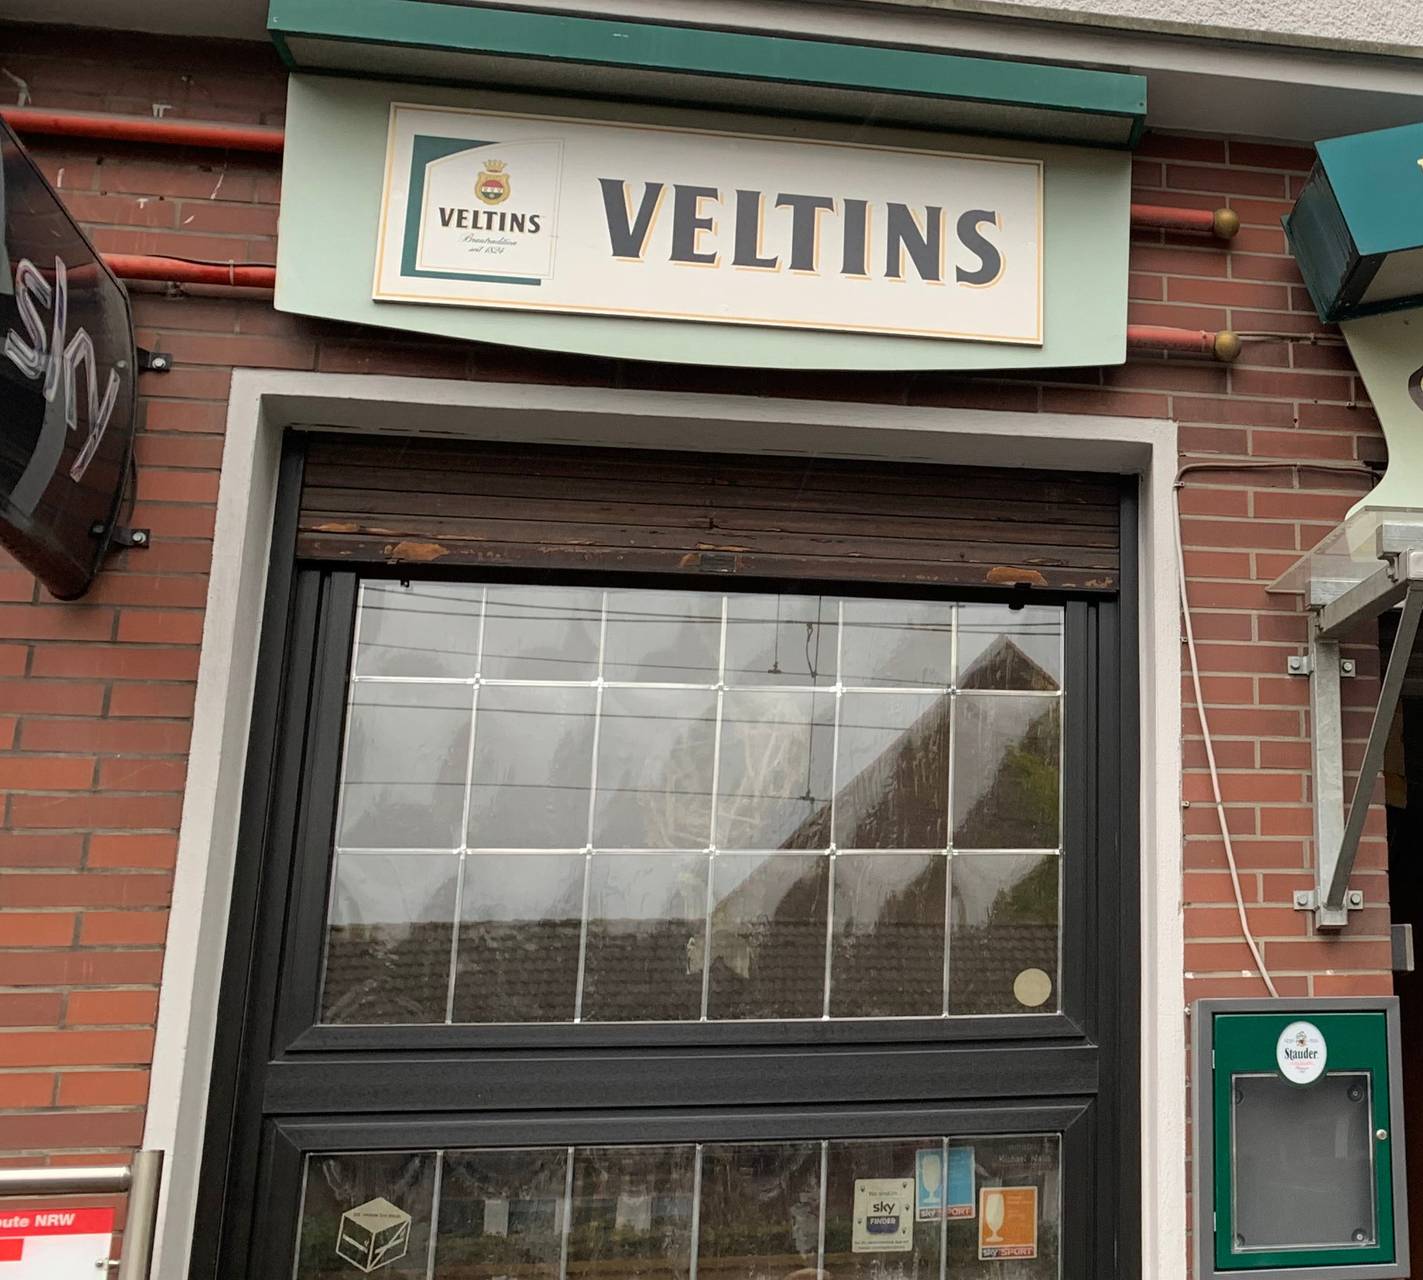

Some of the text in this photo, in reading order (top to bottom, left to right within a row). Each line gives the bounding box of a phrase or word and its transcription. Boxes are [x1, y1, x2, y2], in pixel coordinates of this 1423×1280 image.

[438, 207, 541, 234] VELTINS
[597, 177, 1006, 288] VELTINS
[1284, 1047, 1318, 1061] Stauder
[873, 1201, 895, 1215] sky
[0, 1213, 76, 1229] ute NRW
[870, 1217, 896, 1225] FINDER
[1000, 1247, 1033, 1256] SPORT
